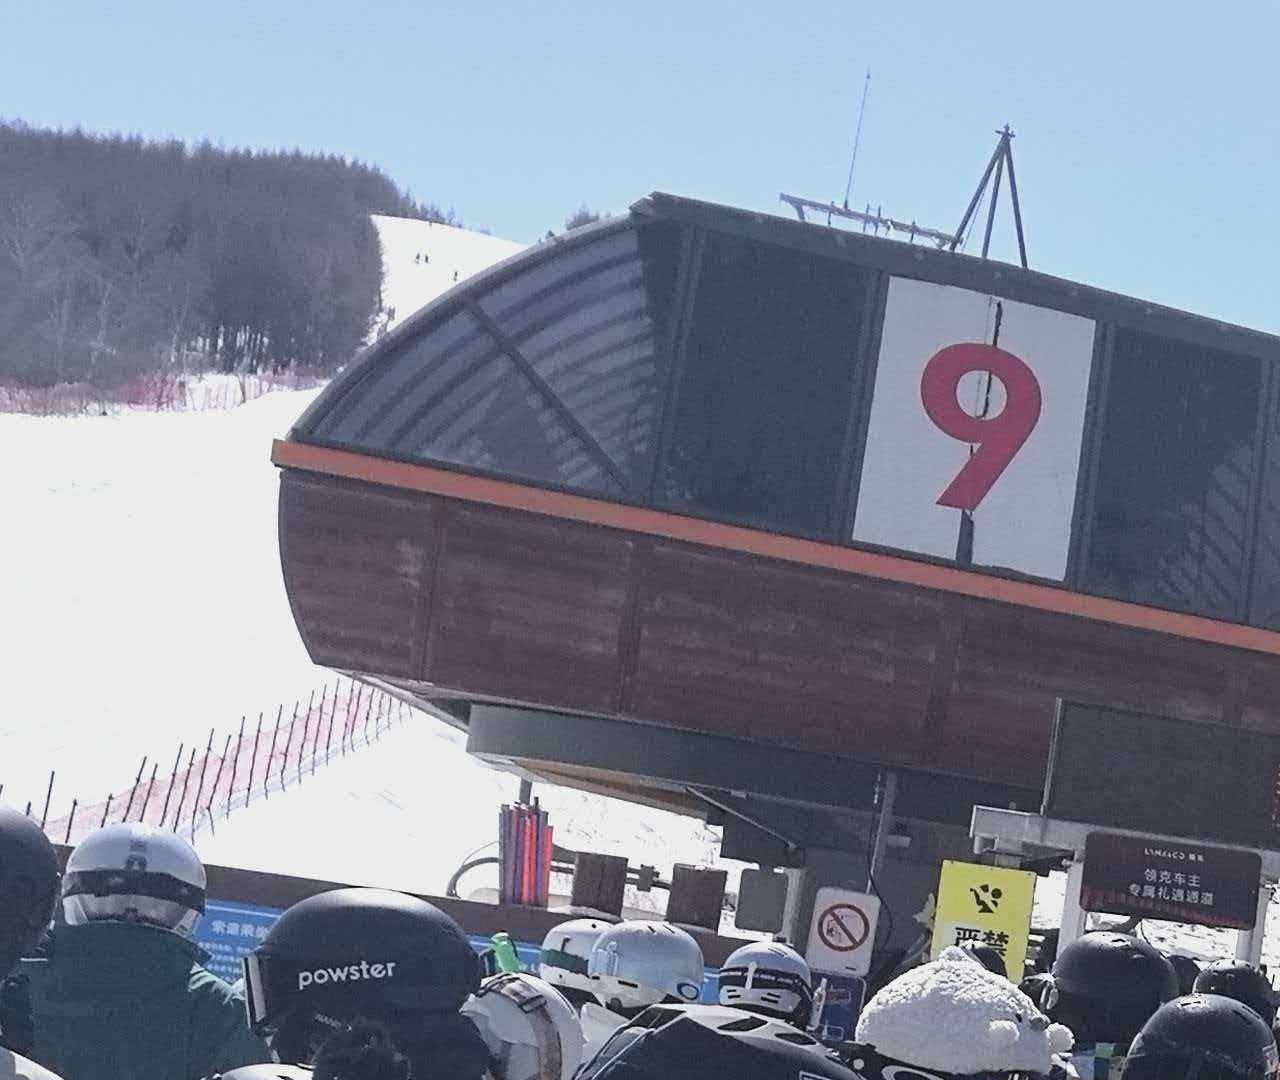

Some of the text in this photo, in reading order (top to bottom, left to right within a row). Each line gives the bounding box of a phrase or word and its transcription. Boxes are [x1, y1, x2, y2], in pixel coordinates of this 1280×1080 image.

[921, 343, 1042, 511] 9
[955, 927, 1009, 957] 严禁
[299, 960, 396, 990] powster
